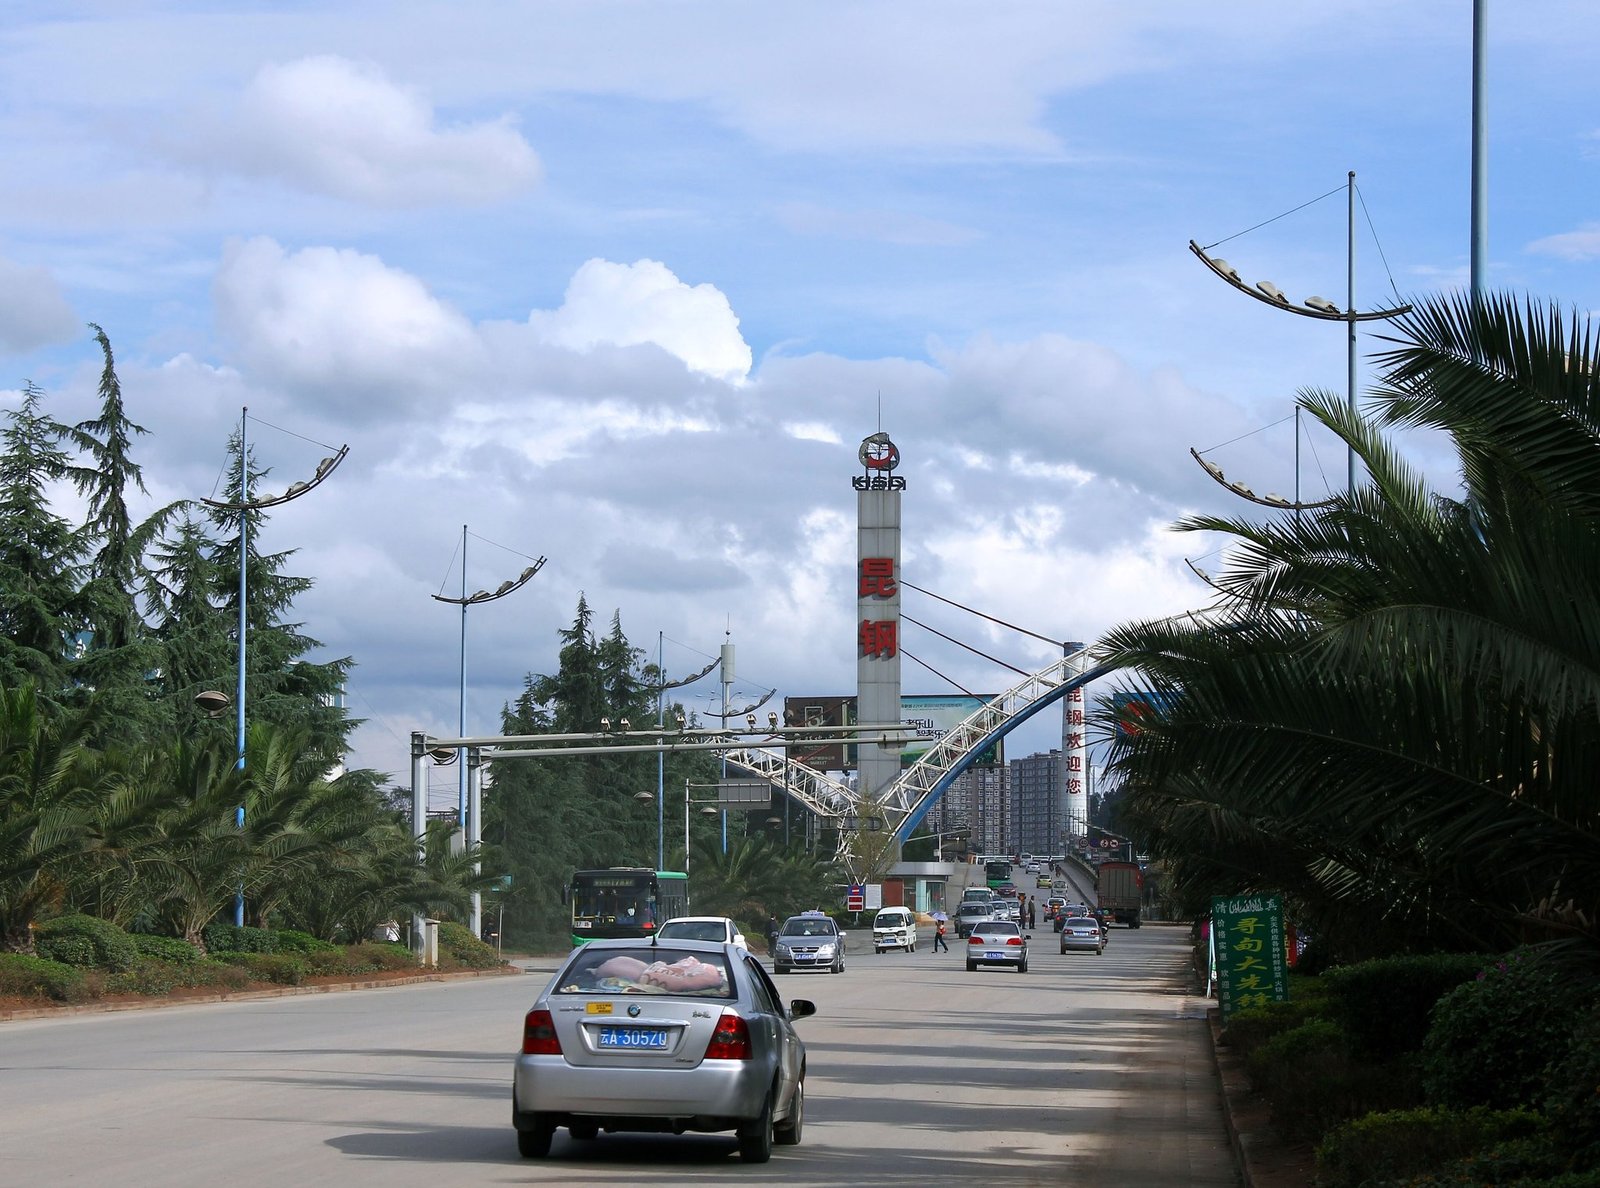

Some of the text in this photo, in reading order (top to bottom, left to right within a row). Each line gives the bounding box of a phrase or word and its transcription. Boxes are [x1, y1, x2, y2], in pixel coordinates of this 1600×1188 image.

[860, 558, 897, 658] 昆钢
[1066, 688, 1082, 794] 昆钢欢迎您
[1215, 902, 1227, 914] 清
[1266, 898, 1278, 912] 真
